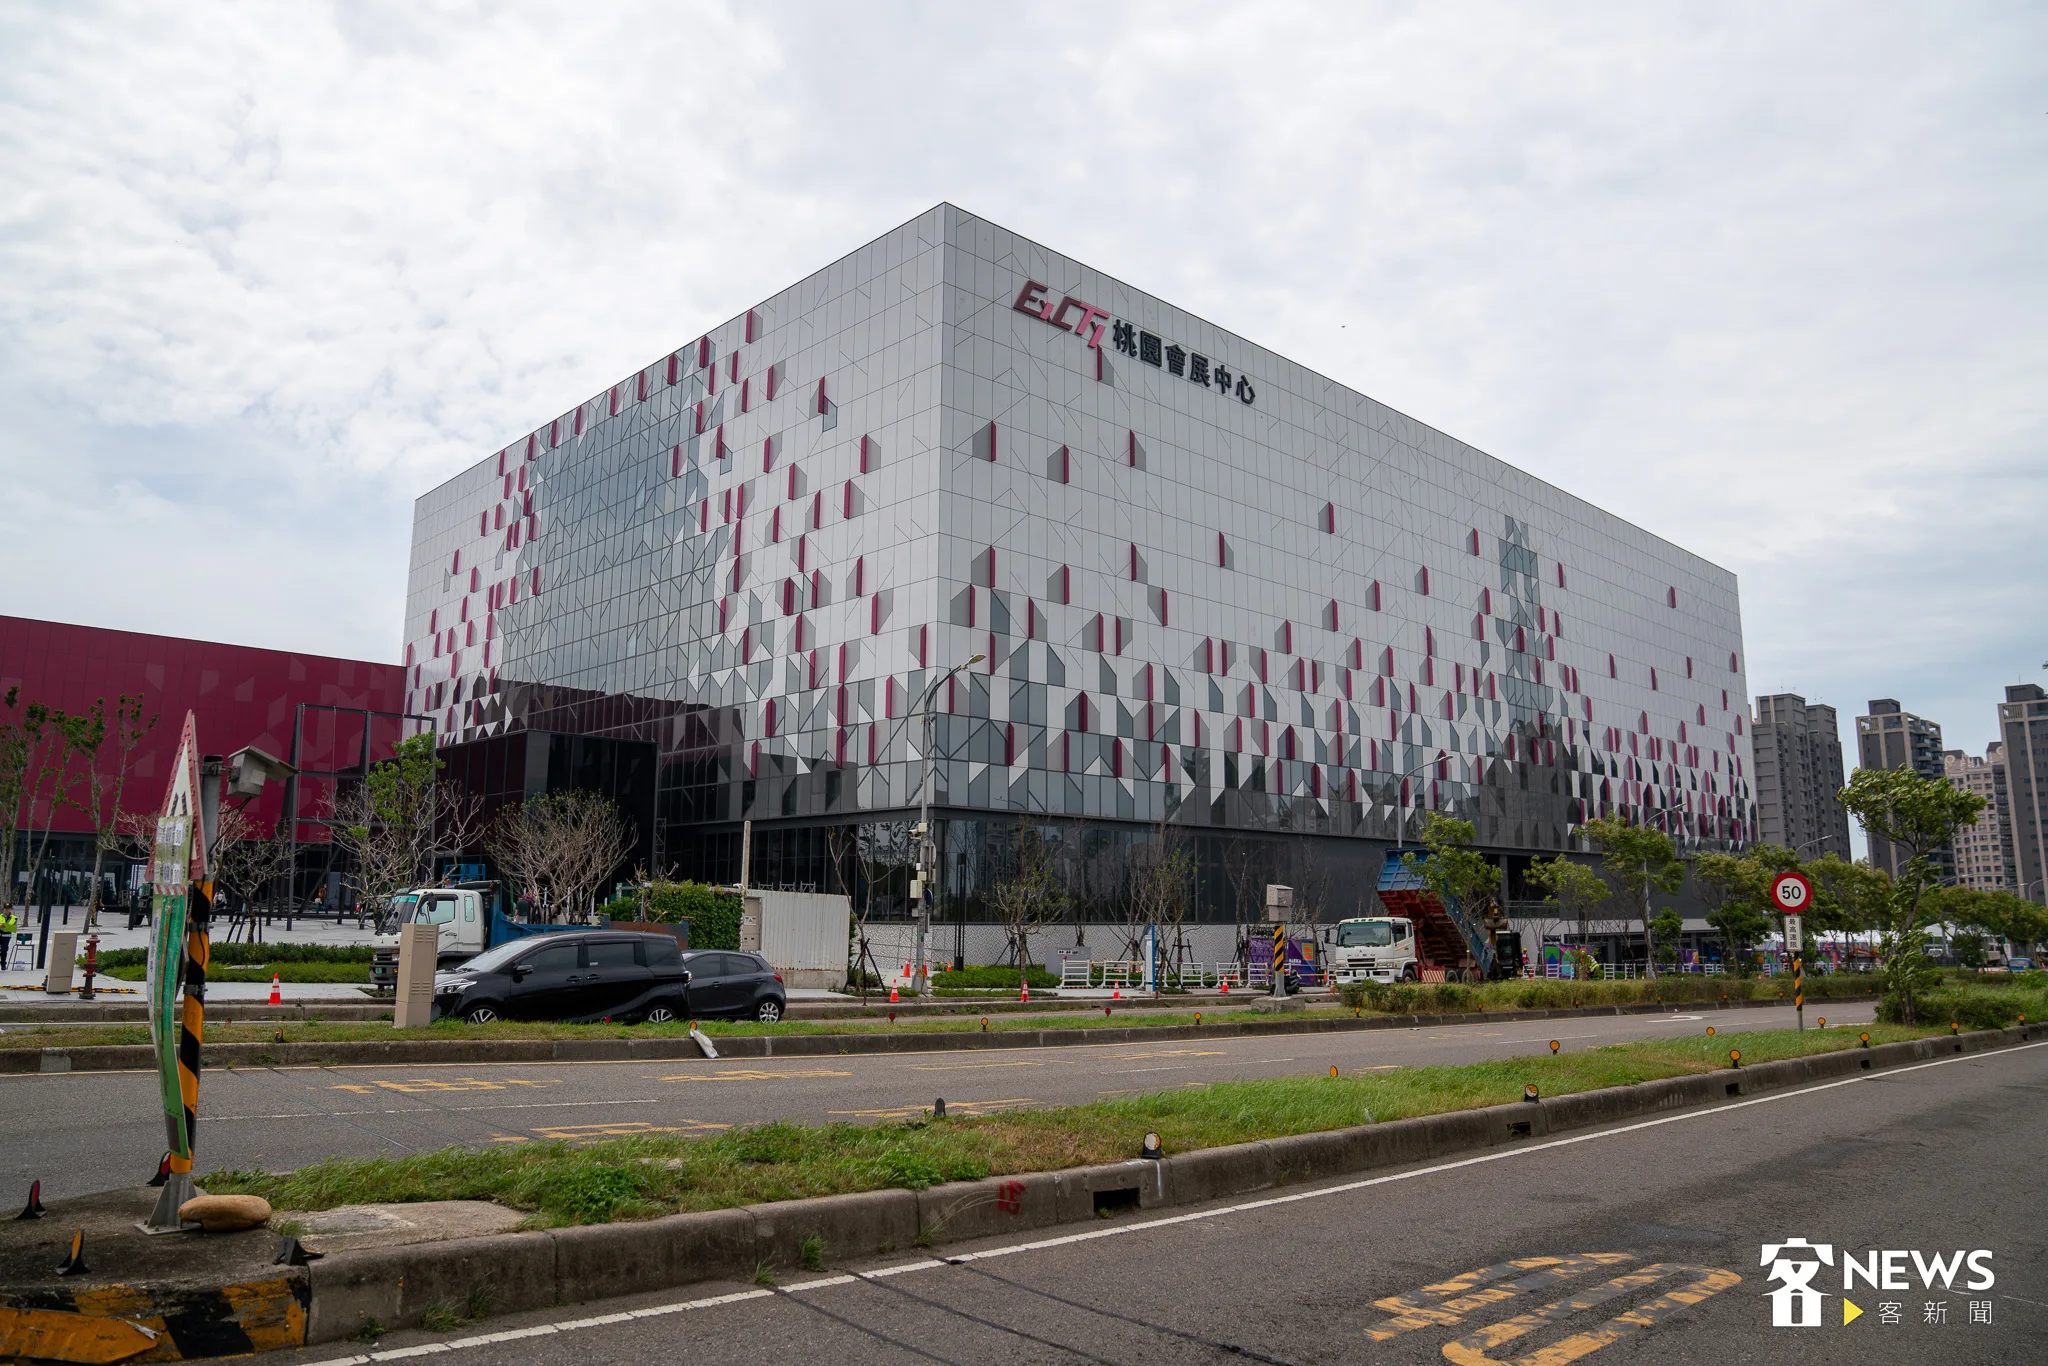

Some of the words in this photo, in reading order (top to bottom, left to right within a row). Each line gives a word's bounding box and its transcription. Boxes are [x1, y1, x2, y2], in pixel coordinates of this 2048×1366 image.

[1112, 318, 1257, 405] 桃園會展中心
[1782, 886, 1801, 899] 50
[1789, 918, 1797, 948] 最高速限
